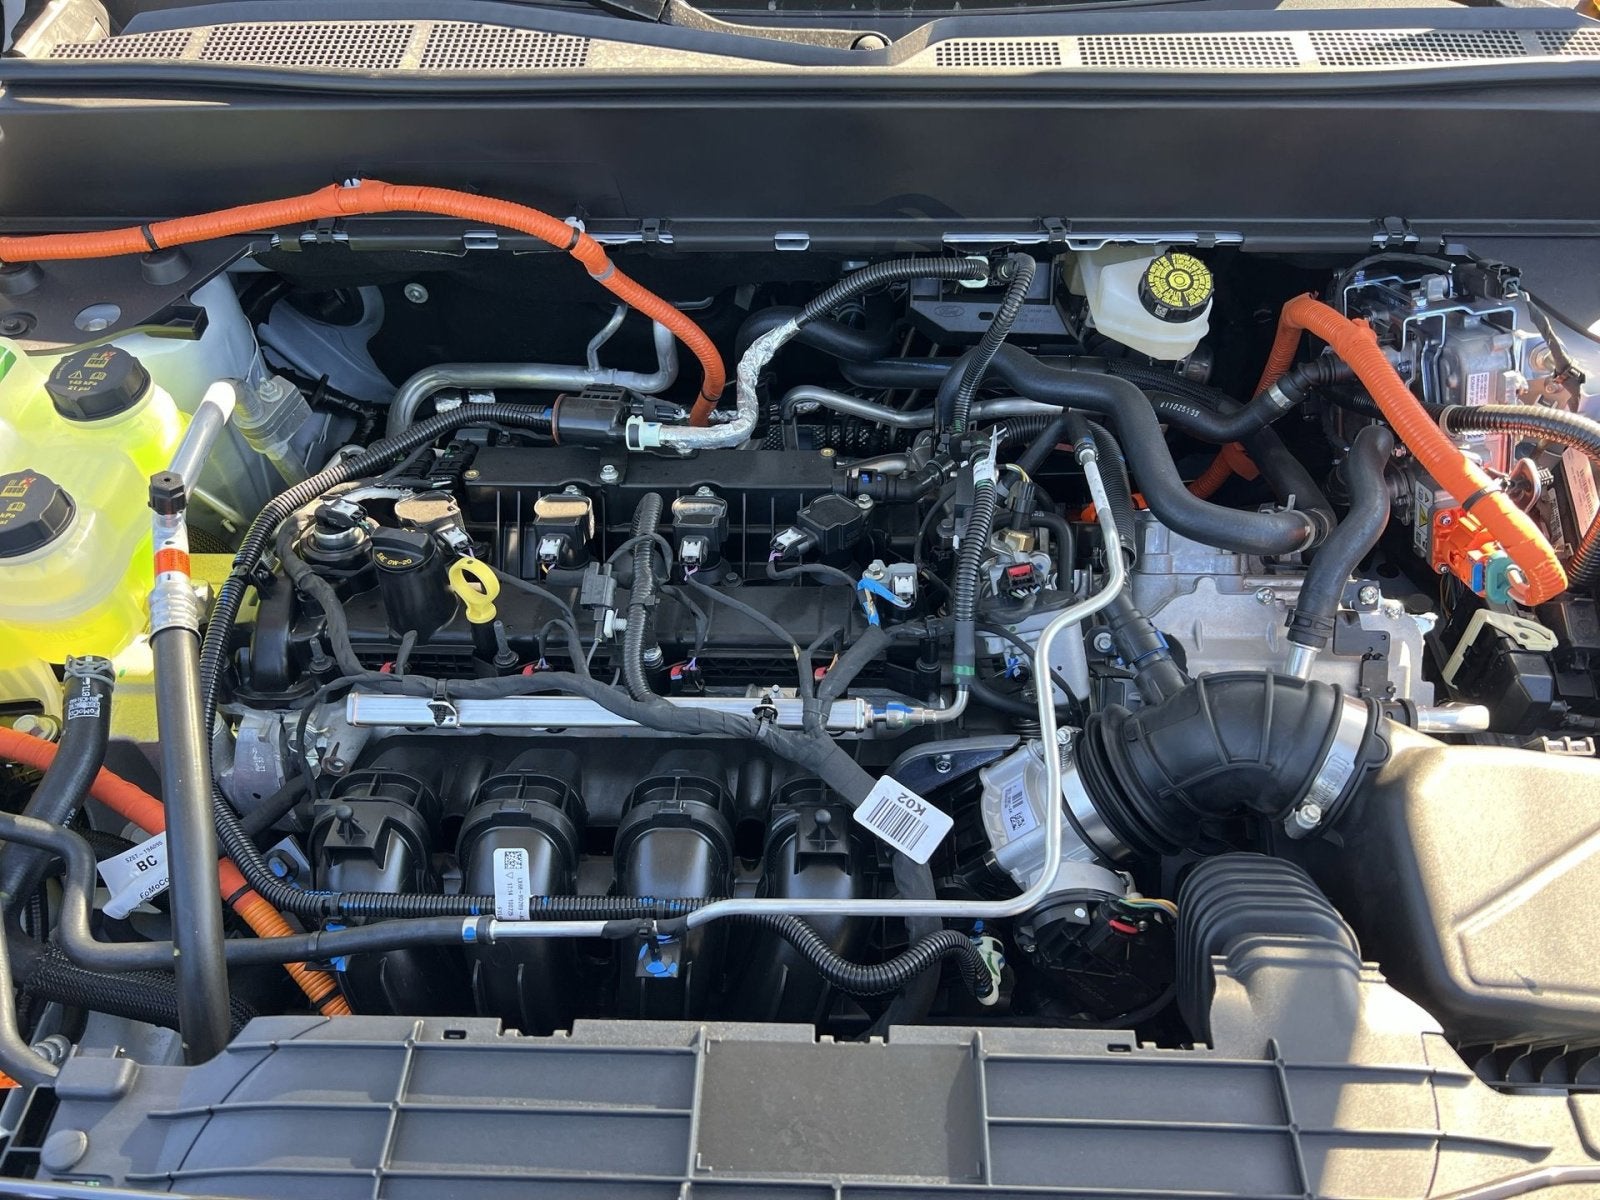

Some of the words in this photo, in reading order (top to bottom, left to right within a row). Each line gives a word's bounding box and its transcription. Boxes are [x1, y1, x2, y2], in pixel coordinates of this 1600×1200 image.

[376, 552, 388, 562] SAE
[898, 792, 927, 816] K02
[136, 855, 158, 872] BC
[139, 877, 169, 899] FoMoCo
